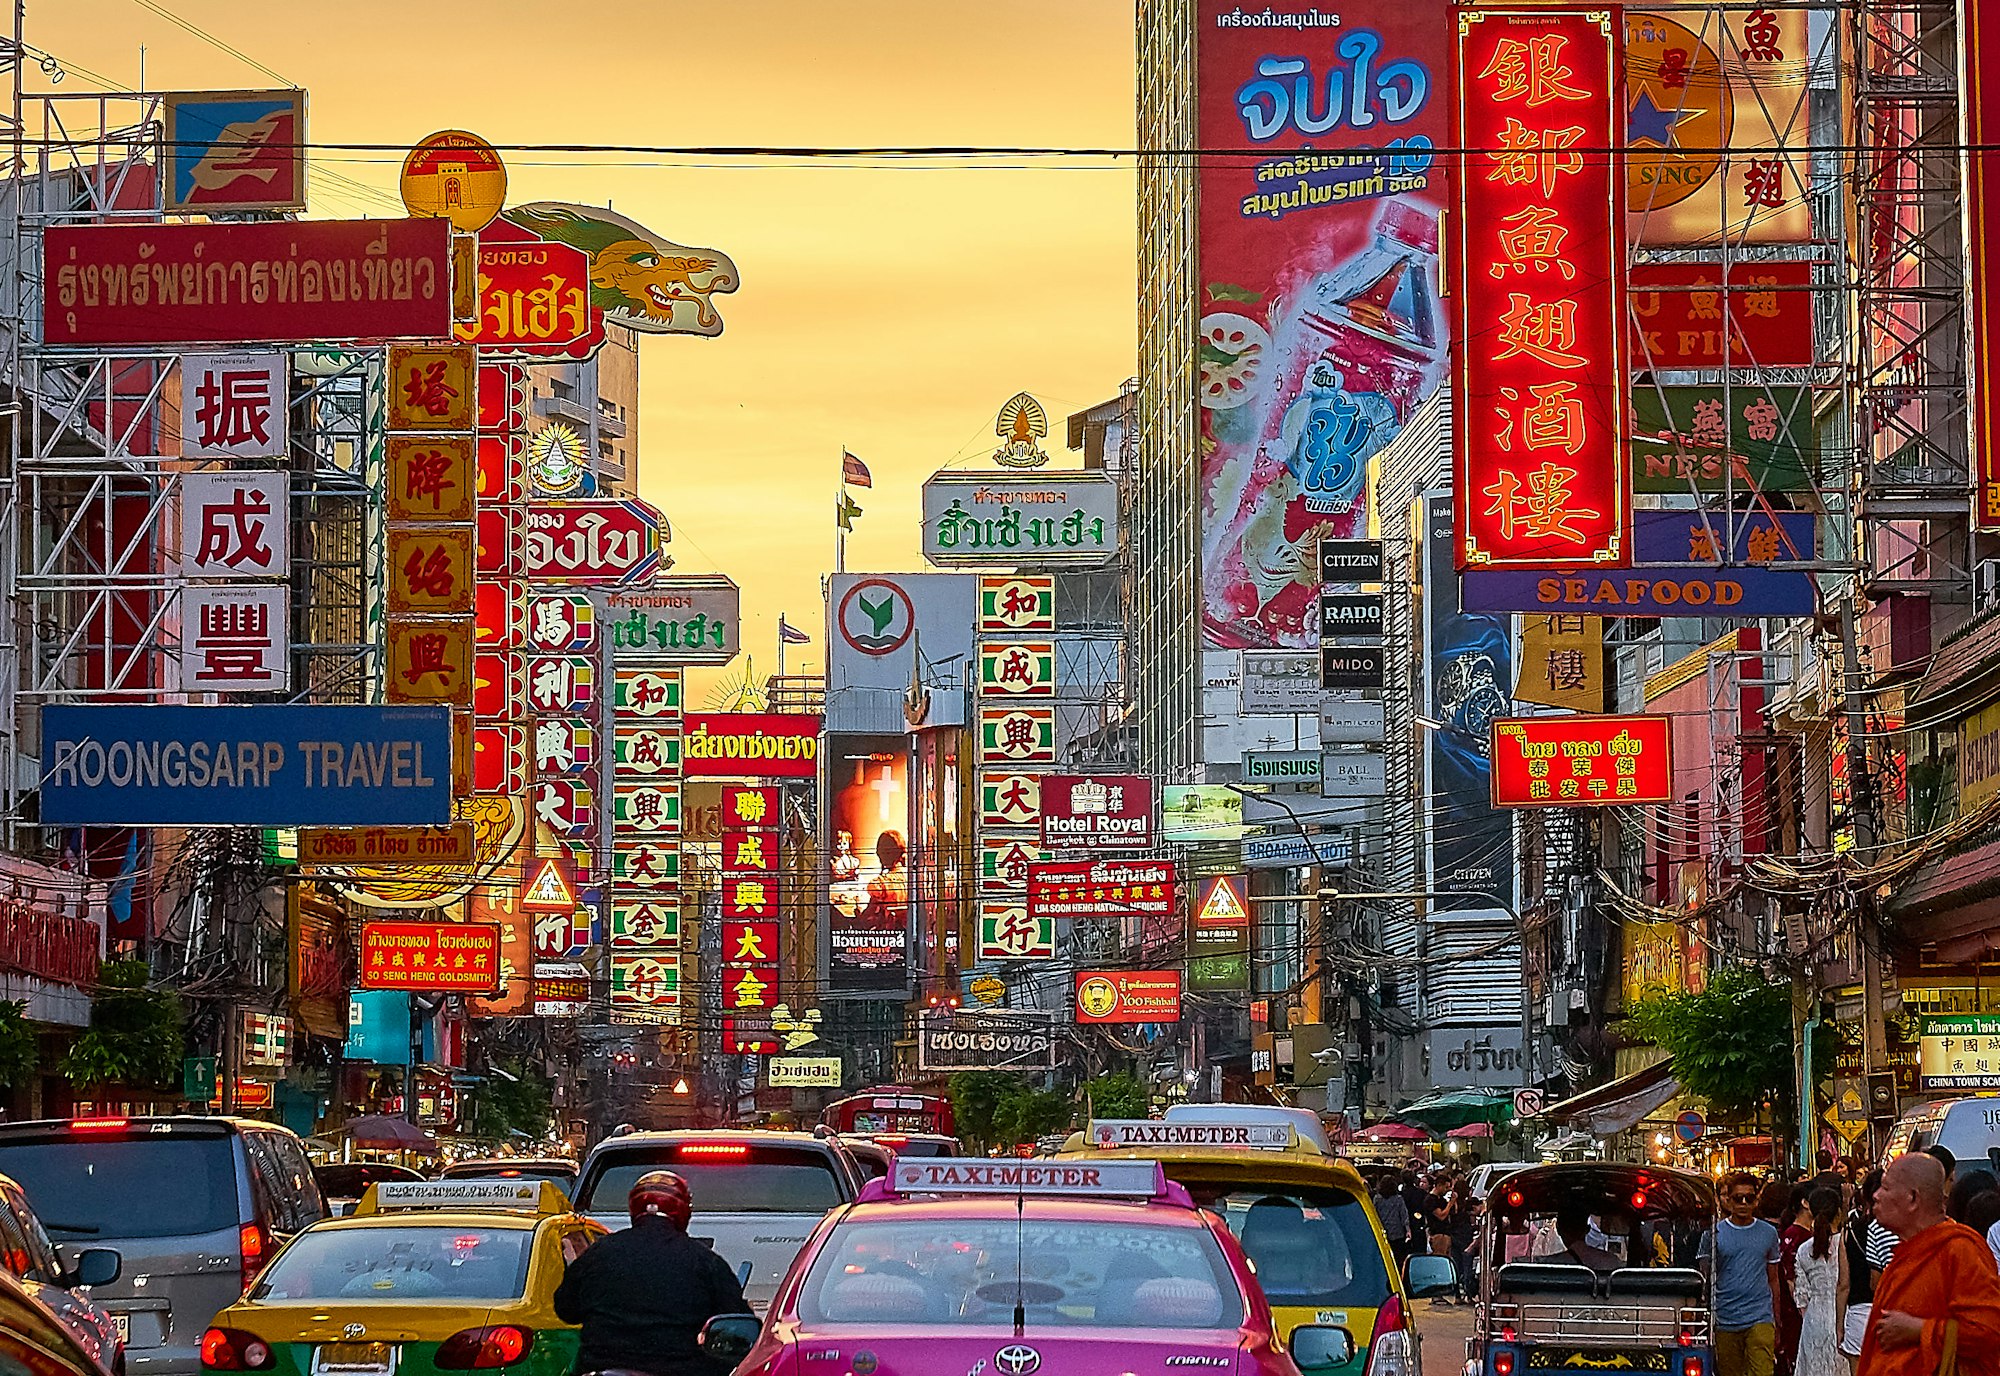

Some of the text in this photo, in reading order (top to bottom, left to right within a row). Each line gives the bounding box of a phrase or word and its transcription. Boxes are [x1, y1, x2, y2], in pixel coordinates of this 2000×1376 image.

[1217, 6, 1341, 31] เครื่องดื่มสมุนไพร
[1239, 32, 1427, 139] จับใจ
[57, 223, 436, 333] รุ่งทรัพย์การท่องเที่ยว
[1476, 33, 1601, 545] 銀都魚翅酒樓
[1324, 554, 1379, 567] CITIZEN
[1536, 579, 1744, 606] SEAFOOD
[1325, 606, 1381, 620] RADO
[1332, 658, 1375, 671] MIDO
[1516, 735, 1558, 758] ไทย
[1561, 741, 1602, 758] หลง
[54, 740, 434, 787] ROONGSARP TRAVEL
[1338, 766, 1370, 775] BALL
[1529, 778, 1637, 798] 批发干果
[1045, 815, 1147, 834] Hotel Royal
[1099, 835, 1147, 845] Chinatown
[367, 971, 492, 983] SO SENG HENG GOLDSMITH
[1144, 997, 1177, 1006] Fishball
[1928, 1077, 1954, 1088] CHINA
[1955, 1077, 1980, 1087] TOWN
[1120, 1126, 1250, 1144] TAXI-METER
[925, 1166, 1102, 1187] TAXI-METER
